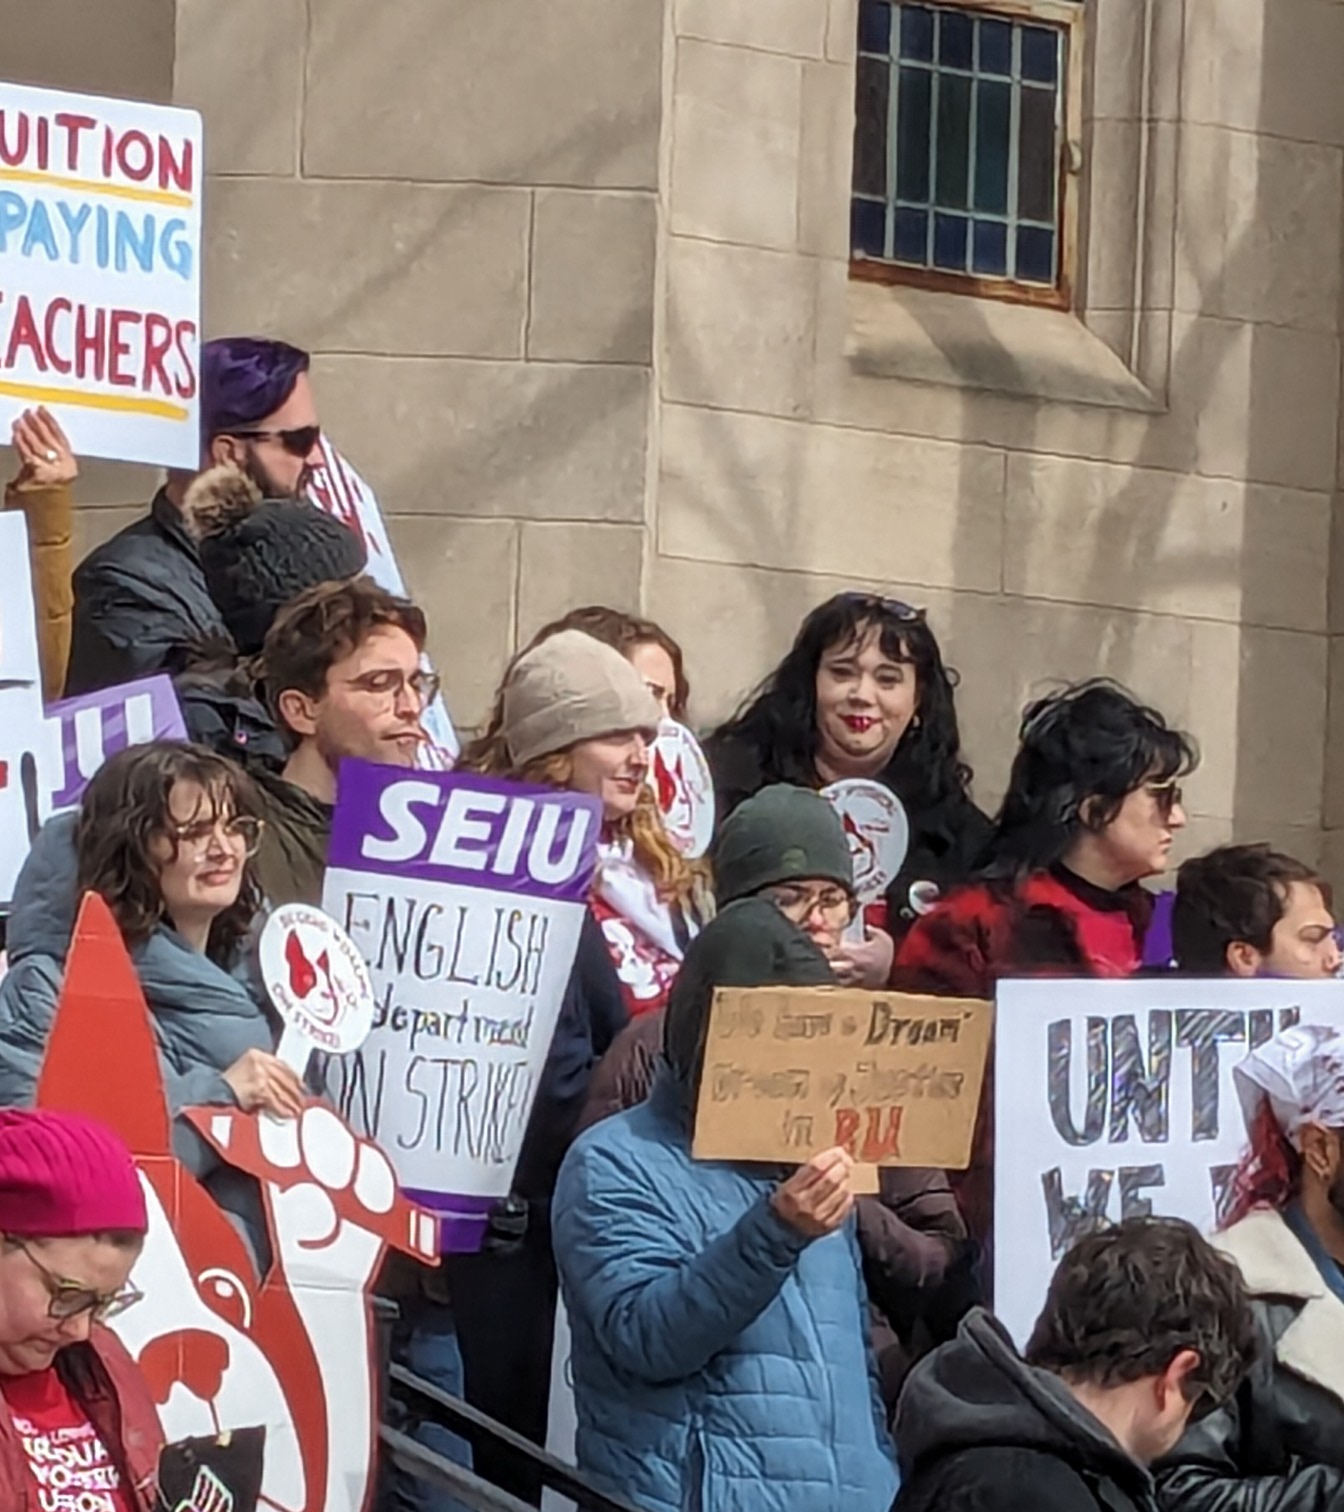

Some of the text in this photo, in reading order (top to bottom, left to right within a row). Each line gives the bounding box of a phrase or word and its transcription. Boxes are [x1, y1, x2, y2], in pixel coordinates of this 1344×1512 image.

[361, 780, 591, 884] SEIU
[343, 893, 549, 996] ENGLISH
[1047, 1006, 1300, 1148] UNT
